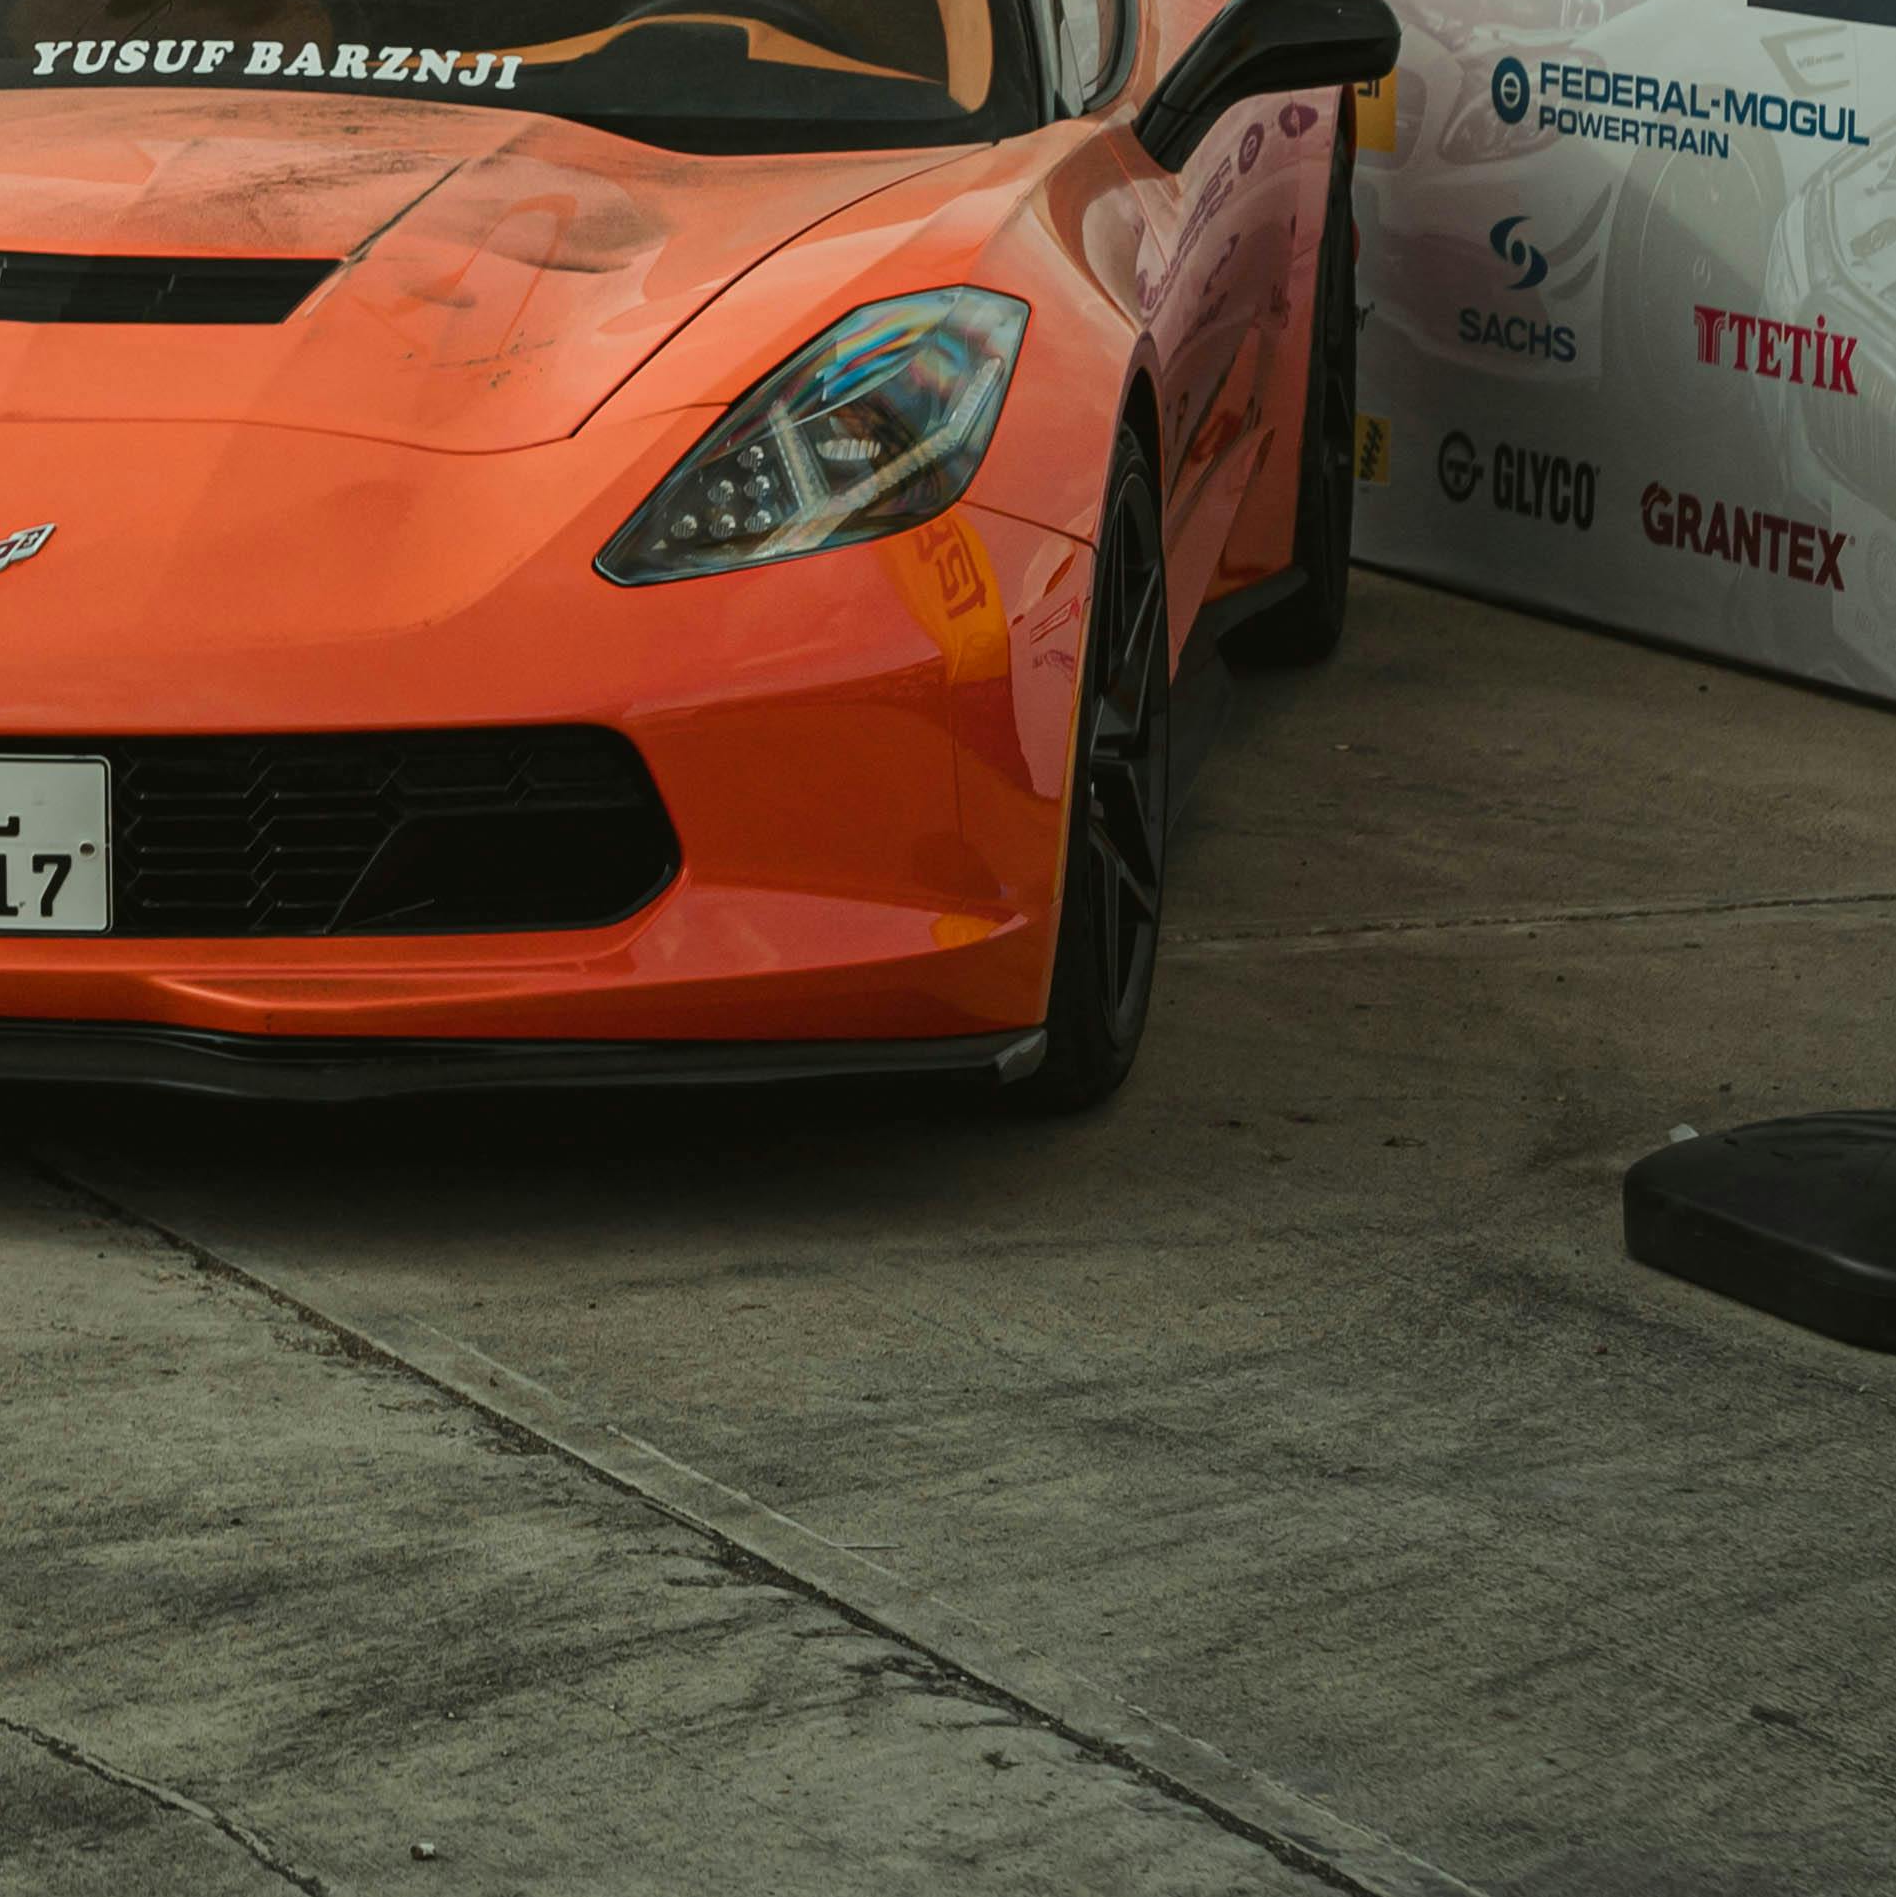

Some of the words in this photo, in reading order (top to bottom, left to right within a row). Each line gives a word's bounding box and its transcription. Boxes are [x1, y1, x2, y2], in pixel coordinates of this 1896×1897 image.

[33, 40, 234, 75] YUSUF
[243, 42, 523, 89] BARZNJI
[1539, 61, 1870, 146] FEDERAL-MOGUL
[1539, 106, 1729, 159] POWERTRAIN
[1459, 308, 1577, 363] SACHS
[1493, 442, 1596, 531] GLYCO
[1641, 482, 1846, 592] GRANTEX
